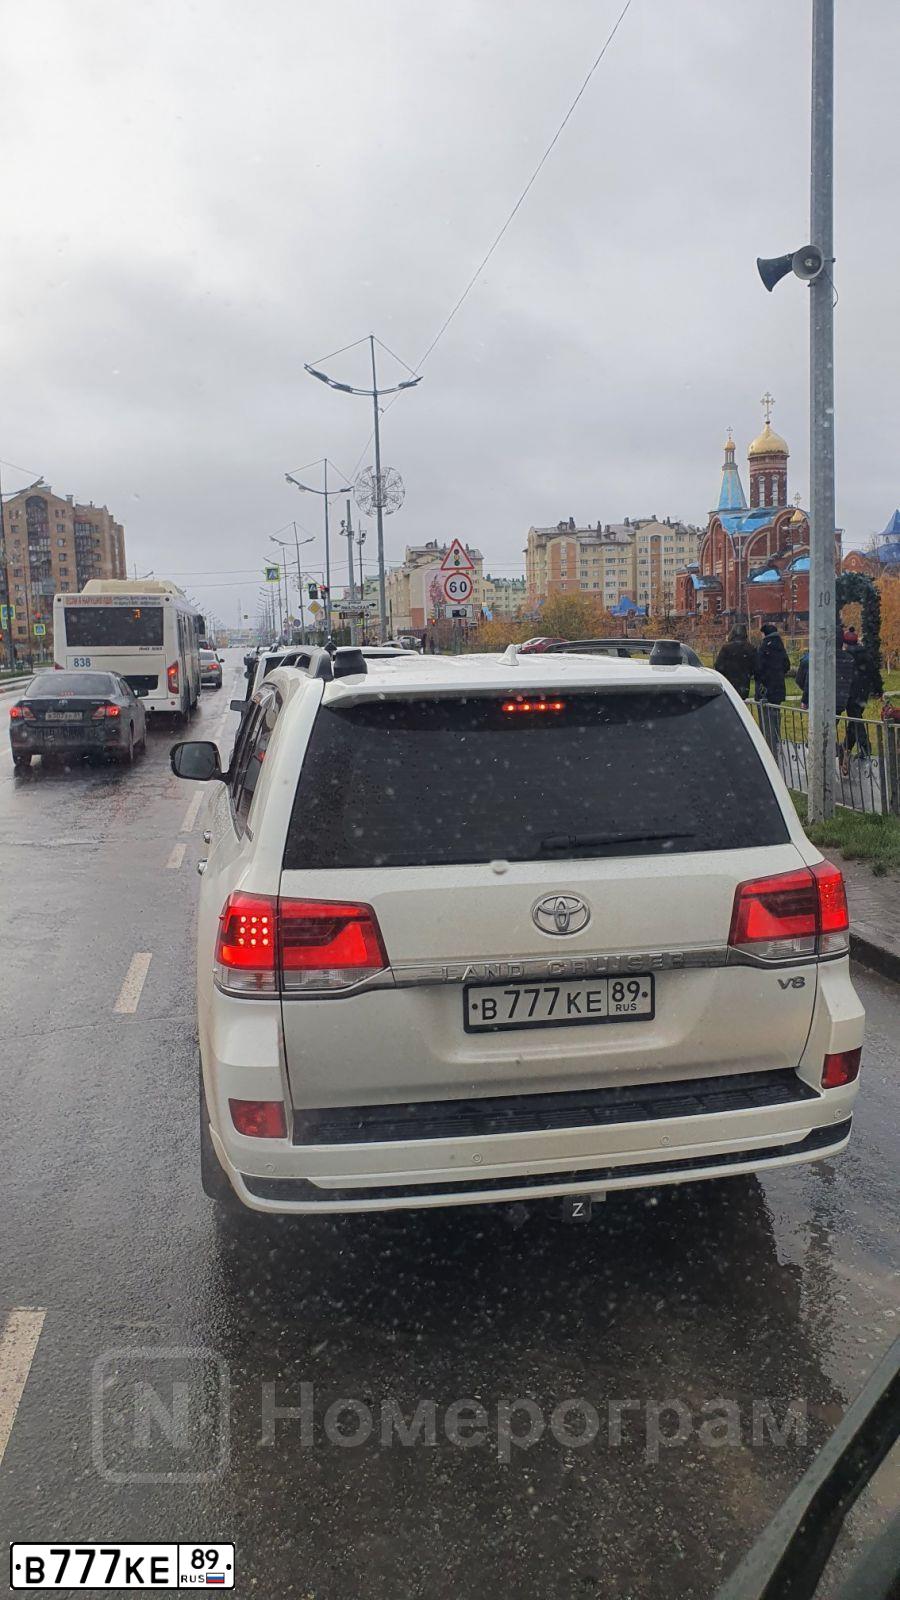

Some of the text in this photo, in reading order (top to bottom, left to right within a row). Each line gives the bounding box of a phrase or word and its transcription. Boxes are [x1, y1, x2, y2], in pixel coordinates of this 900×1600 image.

[450, 581, 467, 593] 60
[818, 591, 831, 608] 10
[73, 658, 91, 667] 838
[442, 952, 686, 982] LAND CRUISER
[777, 976, 806, 990] V8
[611, 980, 641, 1003] 89
[615, 1002, 637, 1012] RUS
[572, 1202, 584, 1217] Z
